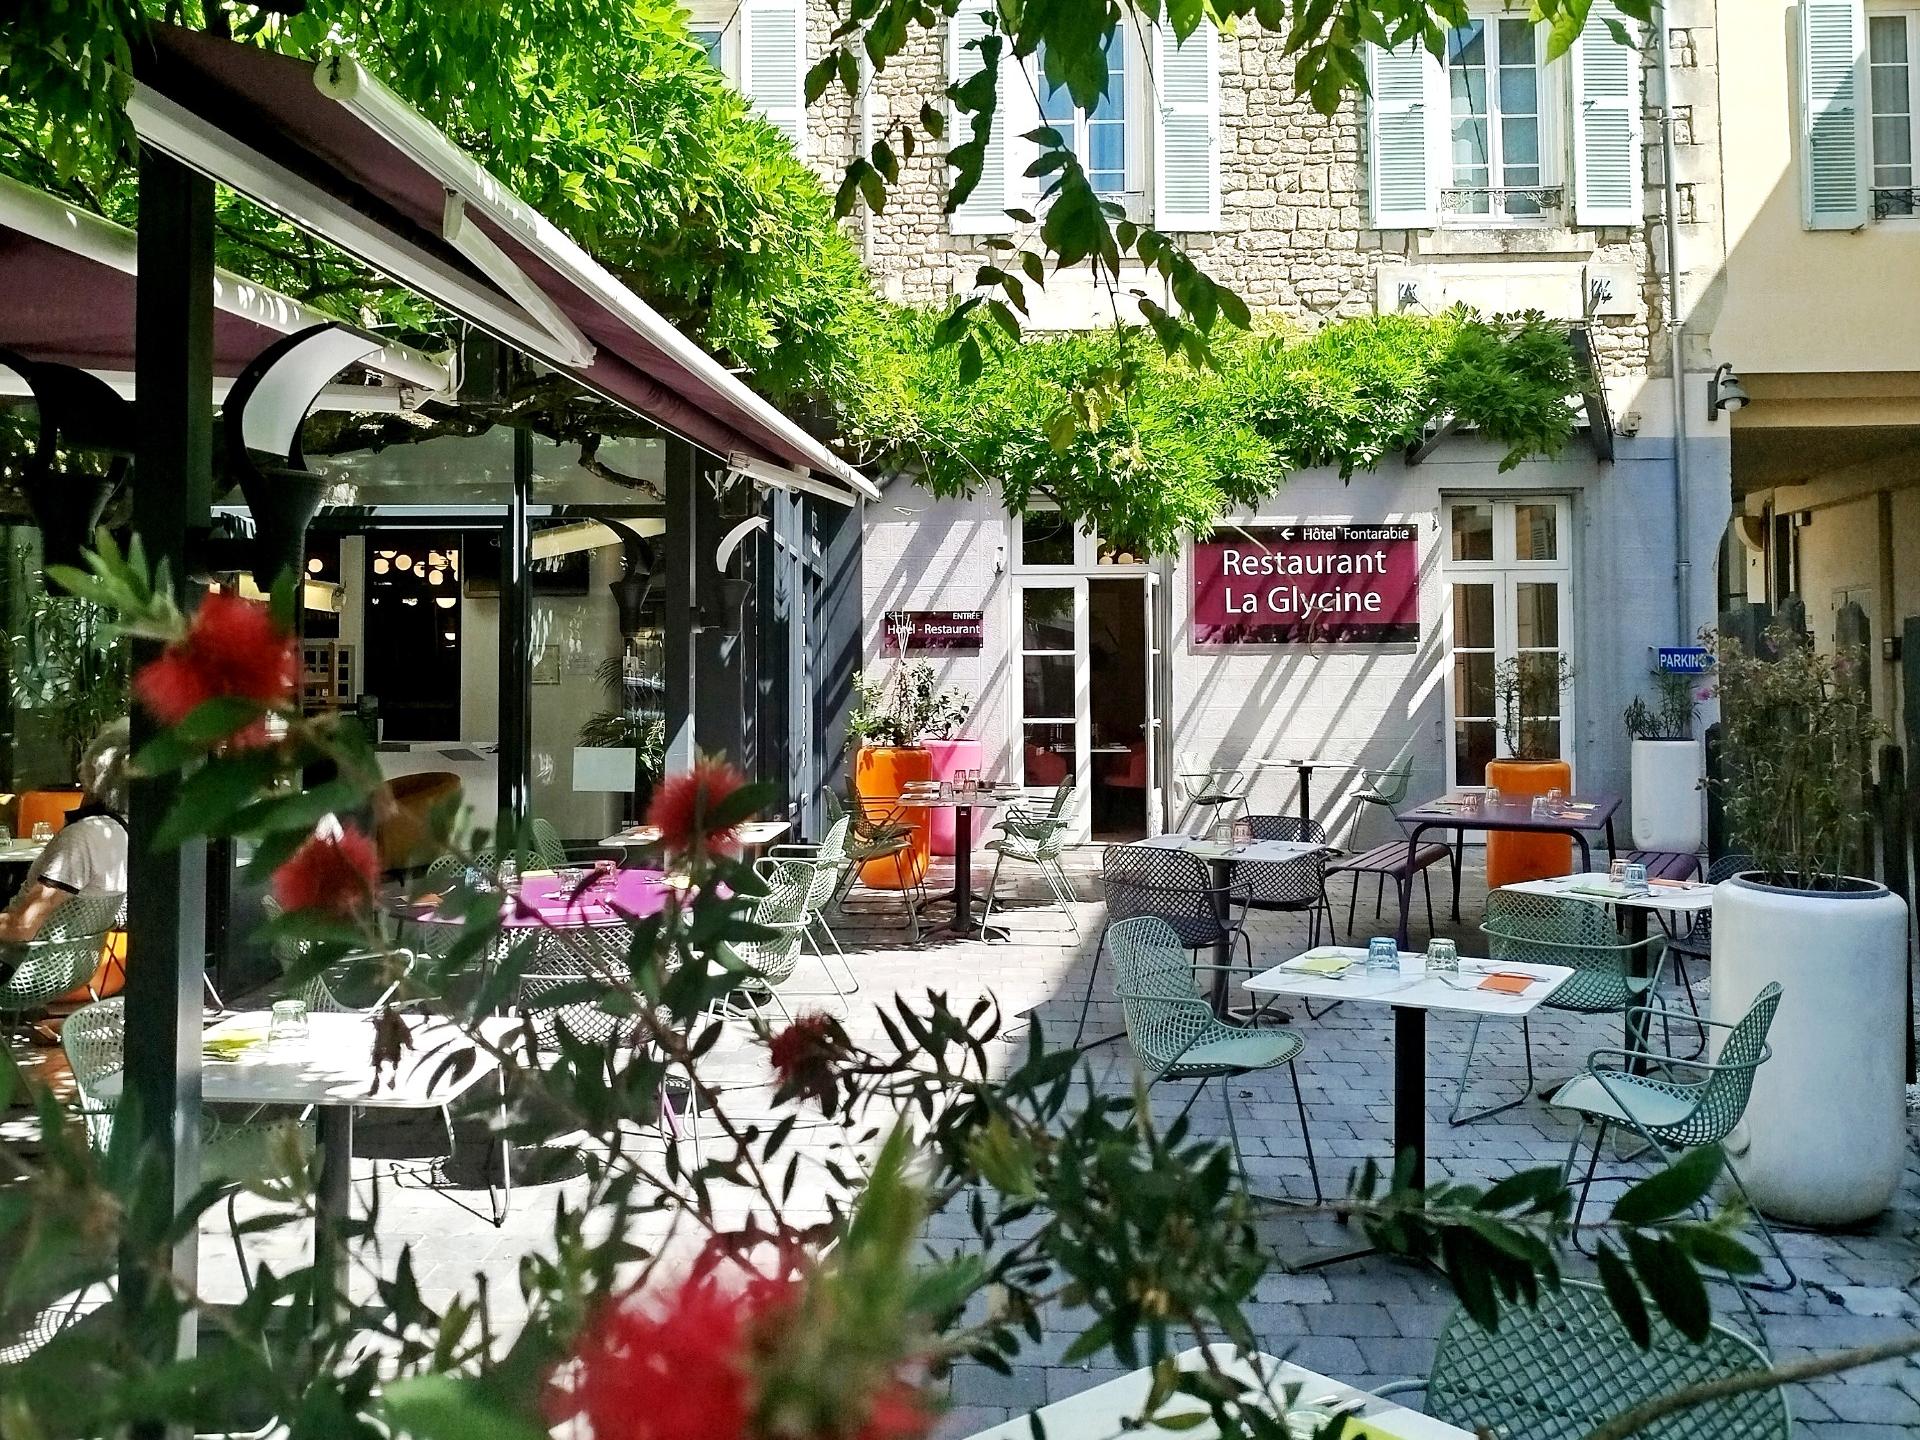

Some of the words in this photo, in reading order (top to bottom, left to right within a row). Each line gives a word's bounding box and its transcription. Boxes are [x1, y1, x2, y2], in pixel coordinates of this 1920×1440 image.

[1303, 527, 1337, 541] Hôtel
[1343, 526, 1410, 541] Fontarabie
[1223, 549, 1387, 576] Restaurant
[1225, 587, 1258, 614] La
[1267, 585, 1382, 620] Glycine
[924, 623, 981, 634] Restaurant
